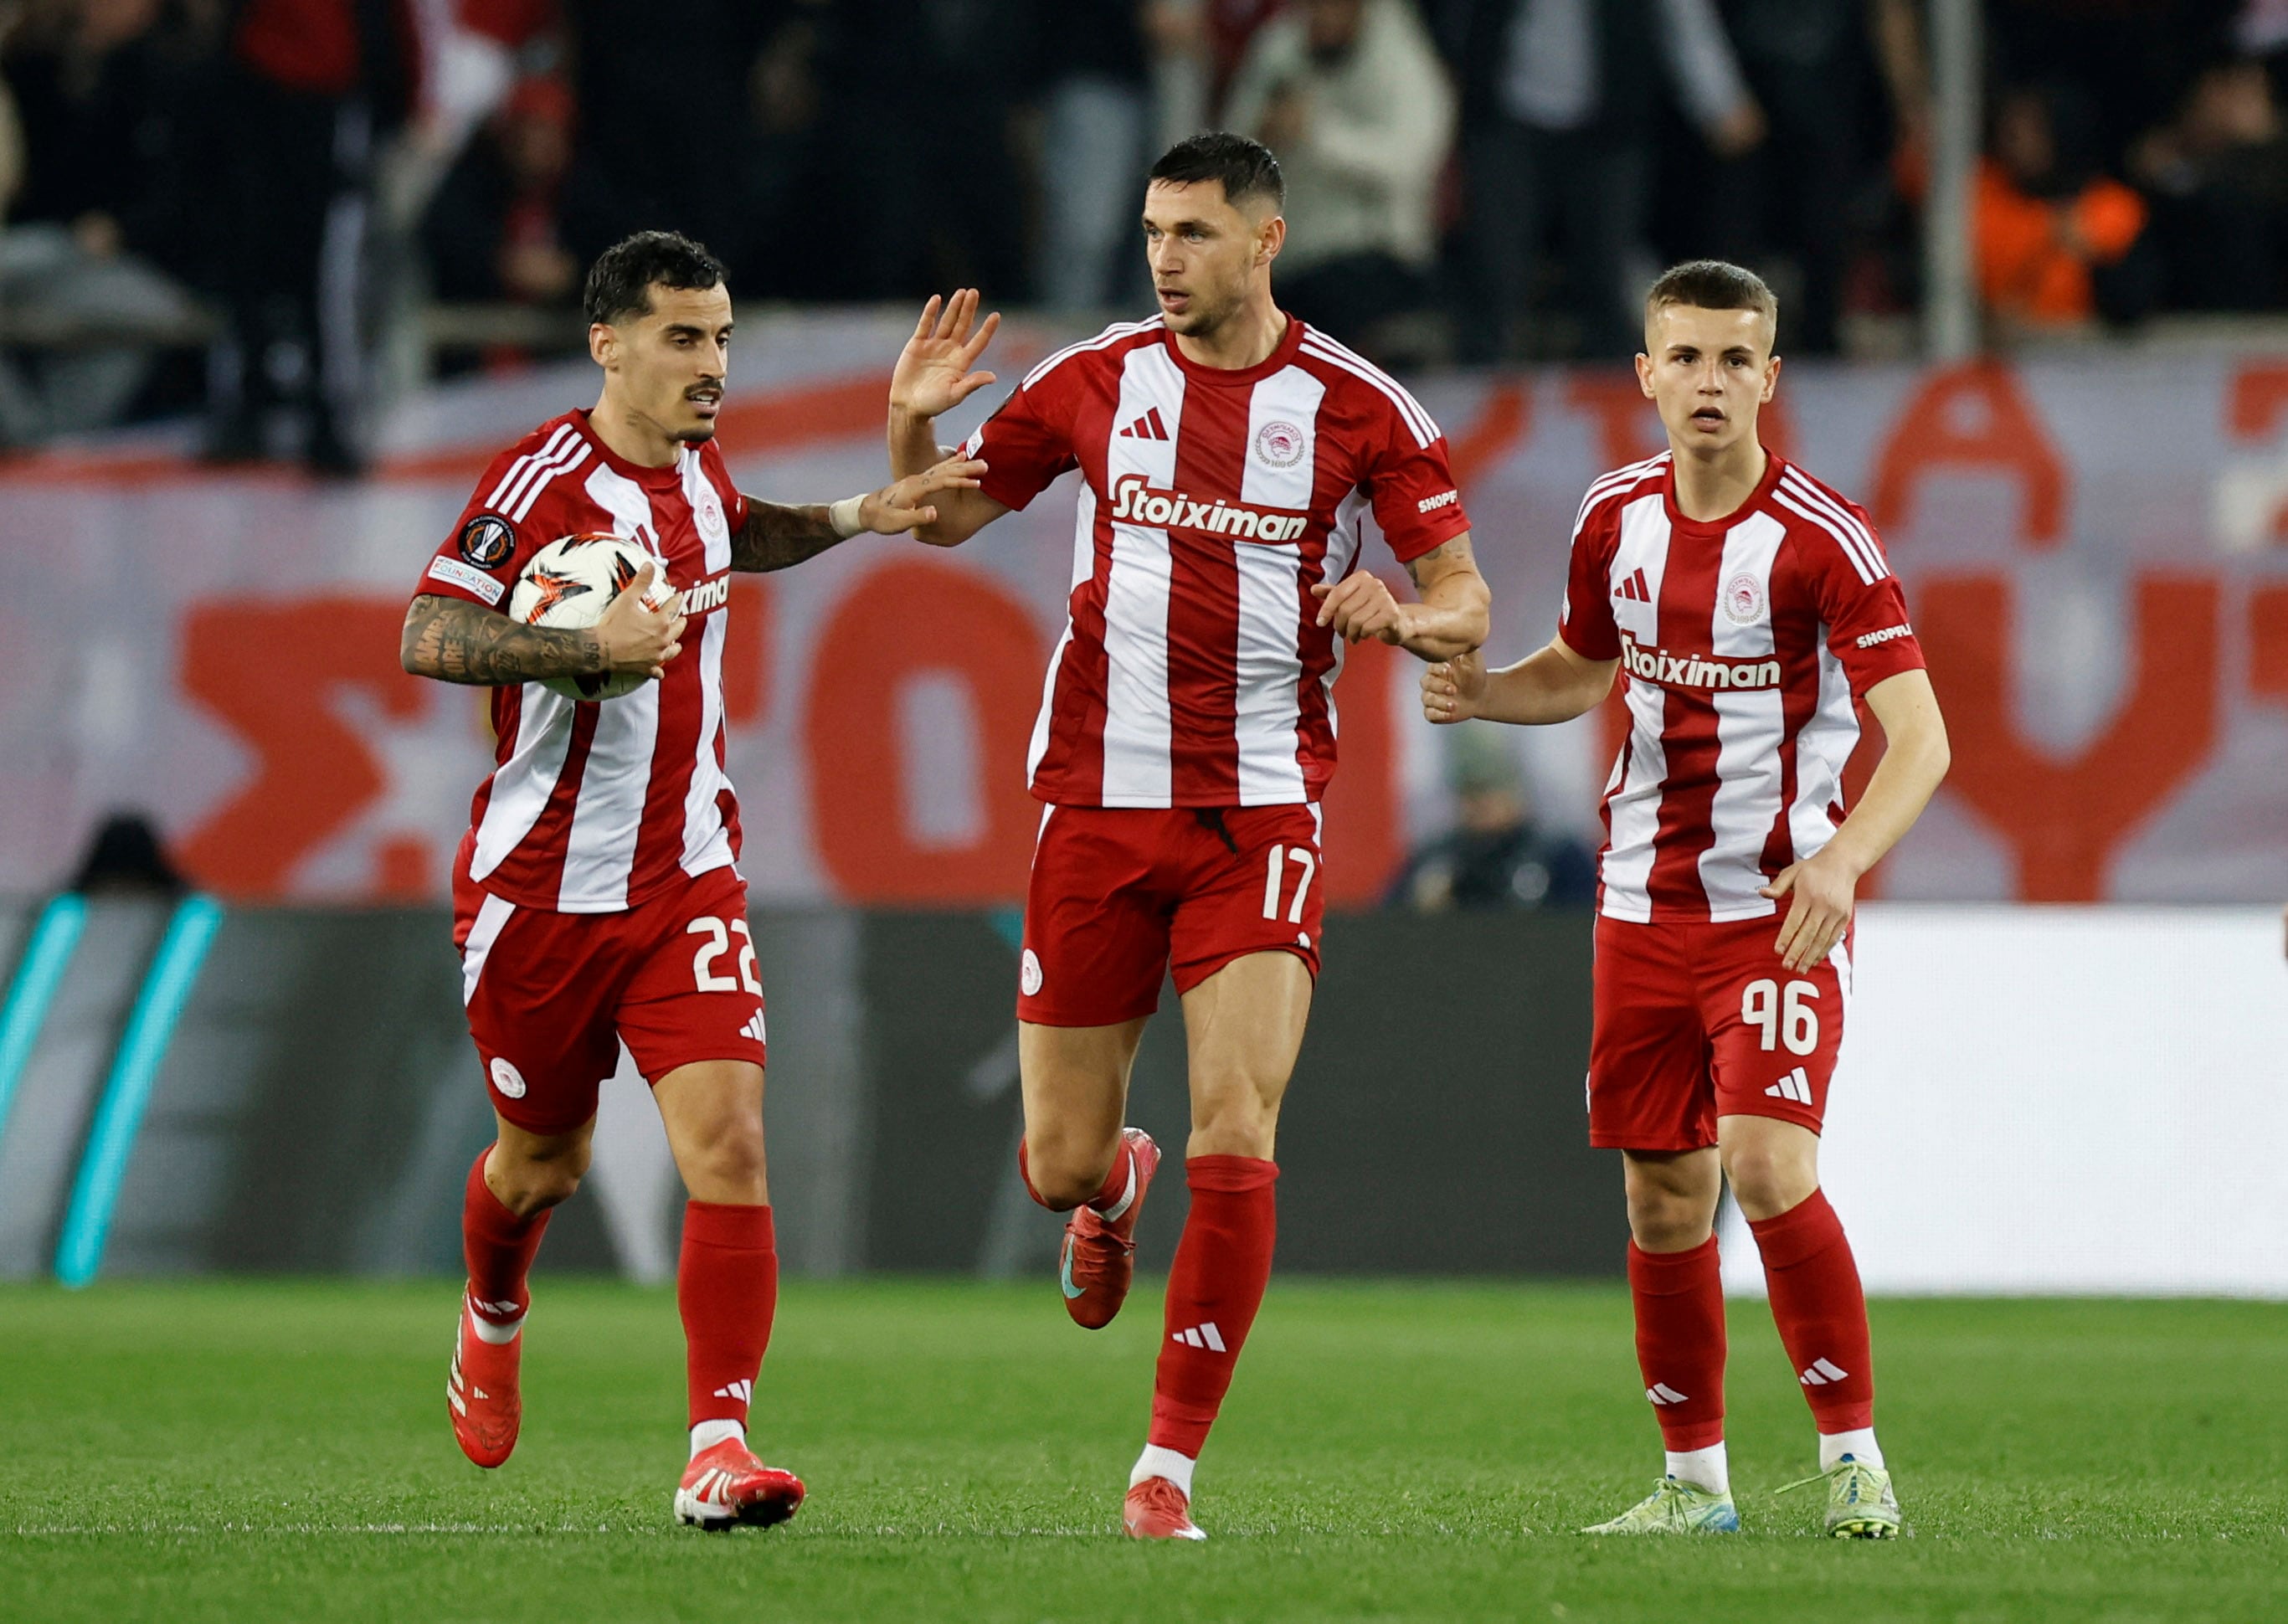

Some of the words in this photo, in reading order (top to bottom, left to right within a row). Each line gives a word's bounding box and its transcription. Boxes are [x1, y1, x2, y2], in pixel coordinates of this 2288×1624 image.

[1113, 480, 1308, 541] Stoiximan
[434, 563, 501, 598] FOUNDATION
[1622, 634, 1781, 688] Stoiximan
[1262, 844, 1315, 924] 17
[686, 916, 763, 998] 22
[1741, 979, 1821, 1056] 96
